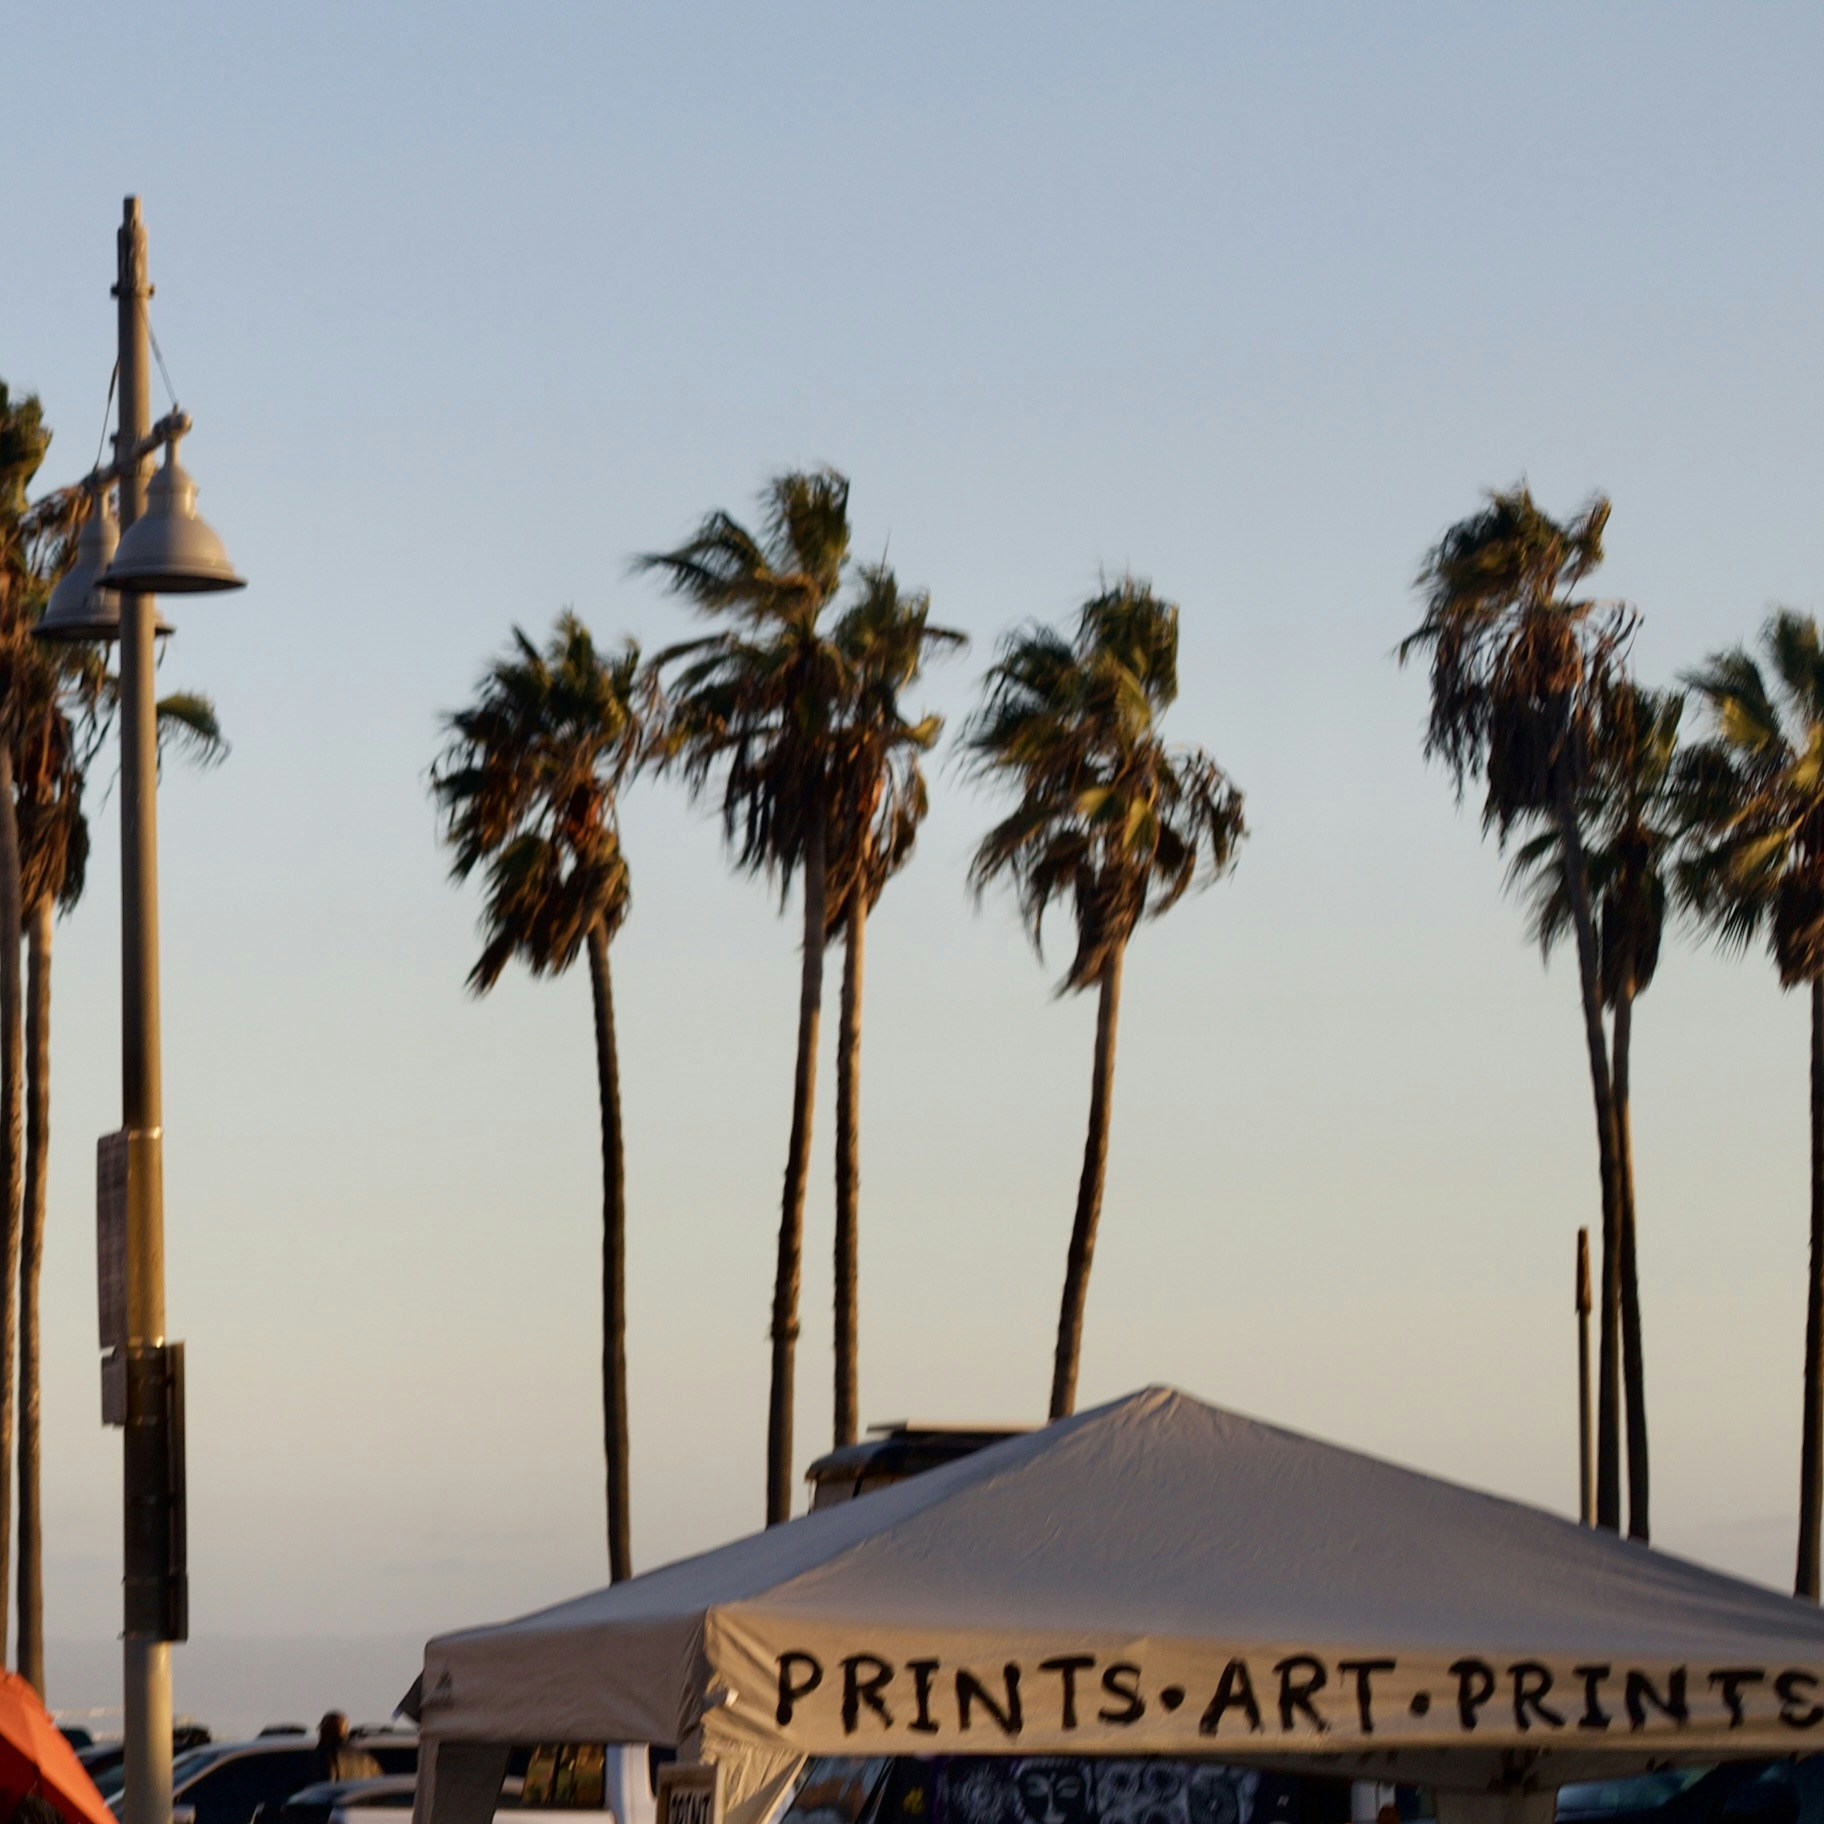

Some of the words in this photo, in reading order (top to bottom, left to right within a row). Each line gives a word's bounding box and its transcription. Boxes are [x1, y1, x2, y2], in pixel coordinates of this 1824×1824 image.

[774, 1651, 1146, 1736] PRINTS
[1198, 1651, 1397, 1736] ART
[1448, 1656, 1824, 1732] PRINTS
